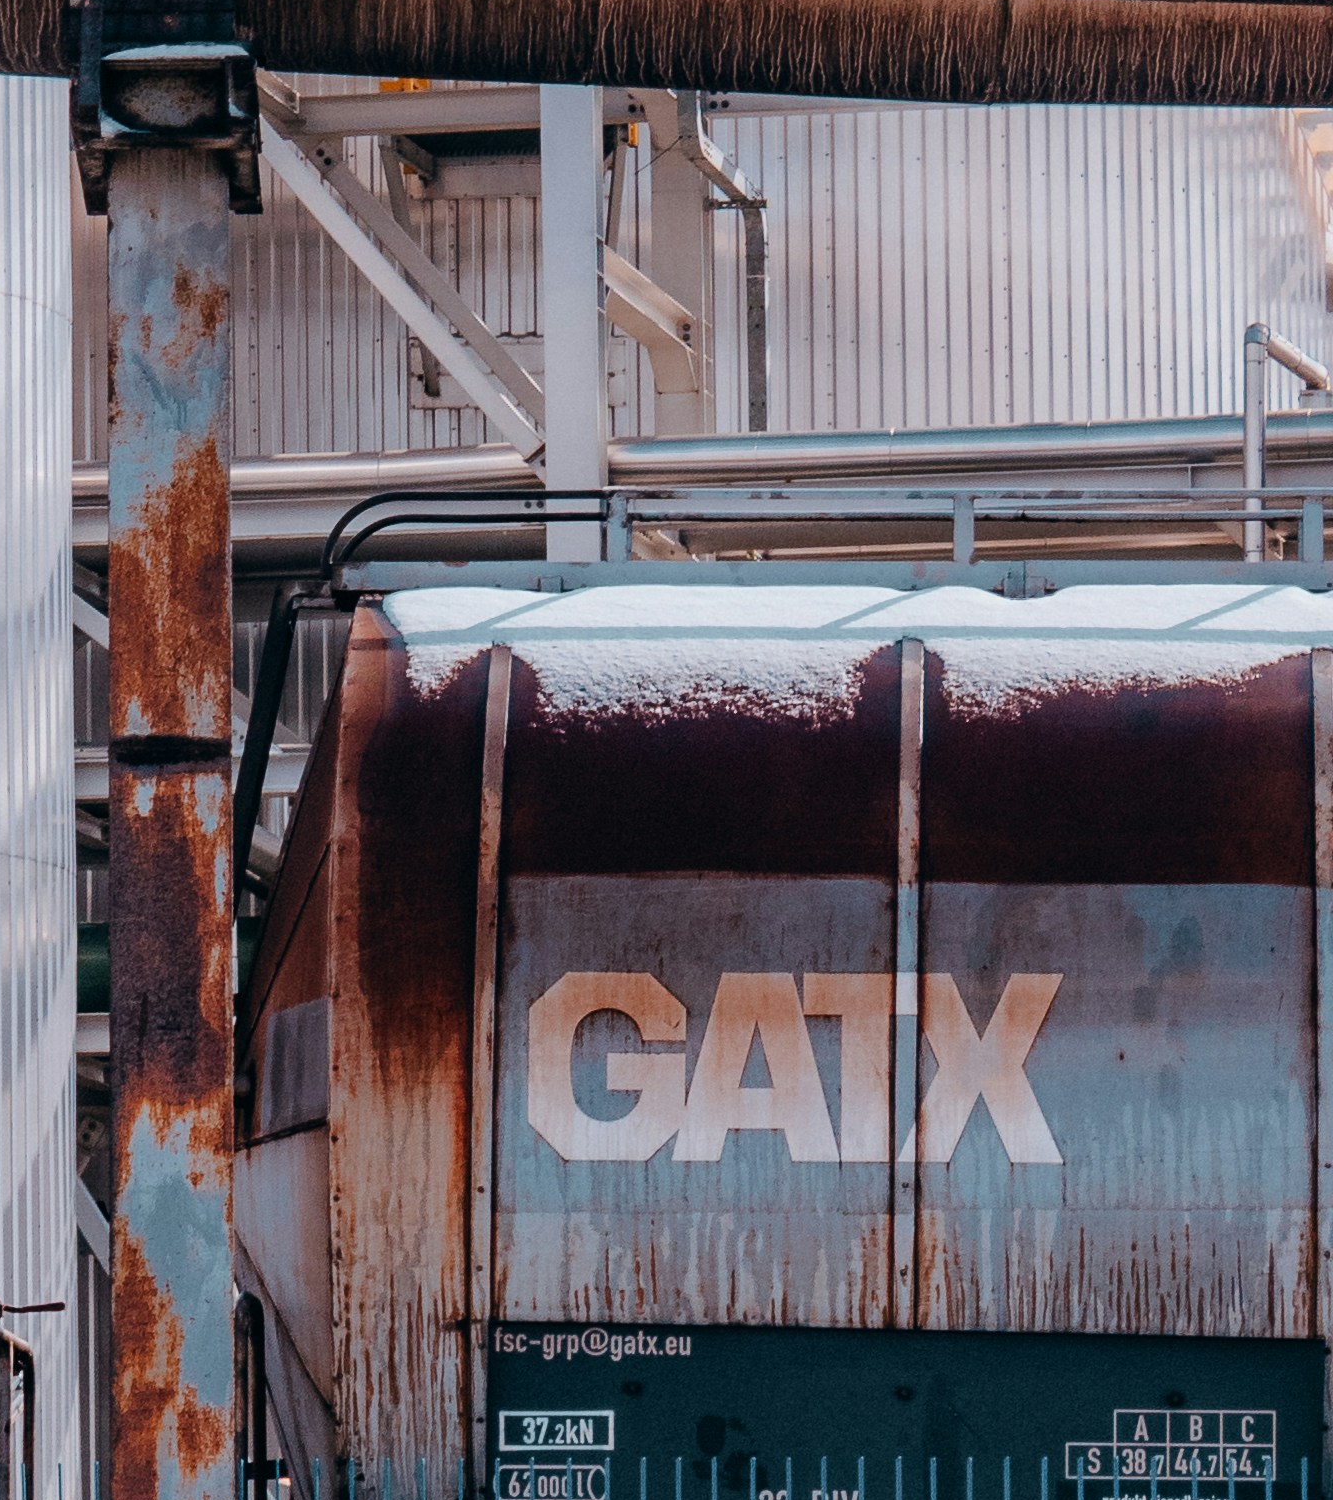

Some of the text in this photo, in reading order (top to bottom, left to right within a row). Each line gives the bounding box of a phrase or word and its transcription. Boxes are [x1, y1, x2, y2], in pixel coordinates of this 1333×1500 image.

[528, 972, 1064, 1166] GATX
[494, 1327, 692, 1361] fsc-grp@gatx.eu
[522, 1417, 594, 1445] 37.2kN
[1133, 1415, 1255, 1442] A B C
[1087, 1447, 1101, 1474] S
[1122, 1448, 1165, 1475] 387
